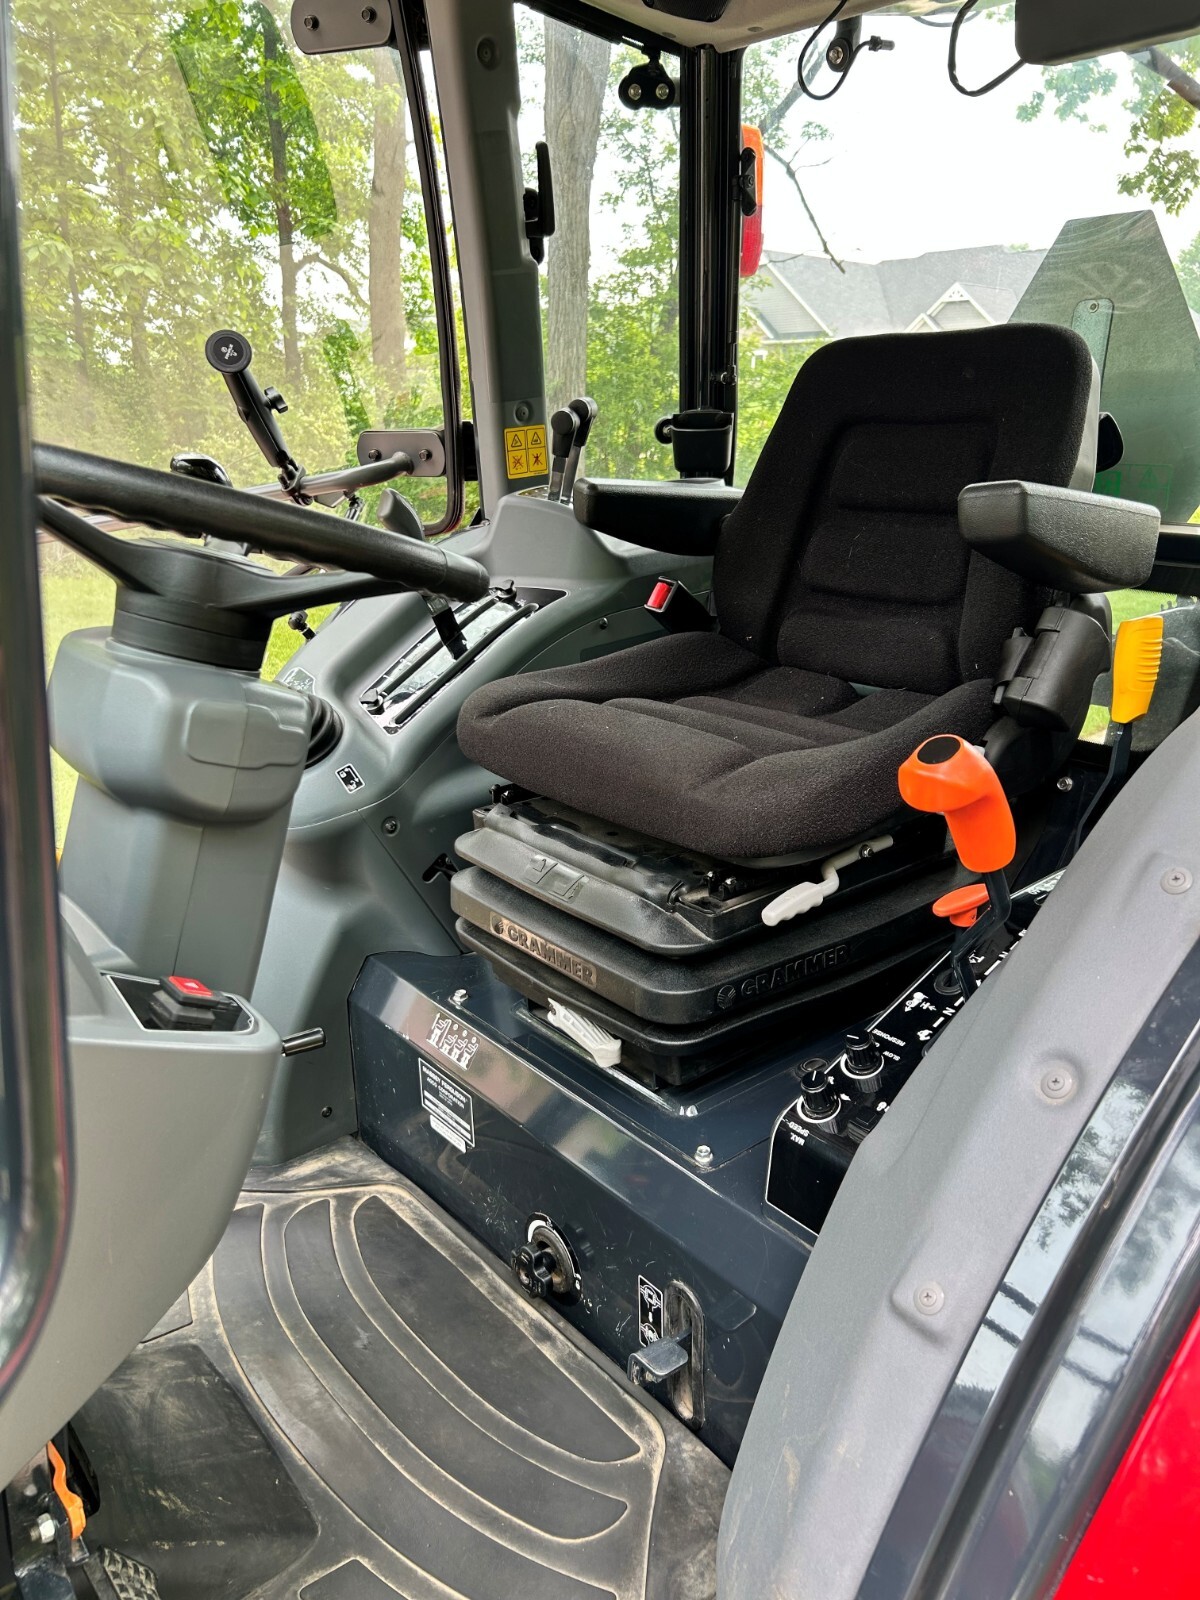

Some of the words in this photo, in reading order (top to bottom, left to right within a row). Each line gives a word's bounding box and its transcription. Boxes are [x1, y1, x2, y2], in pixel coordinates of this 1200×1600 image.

[507, 925, 593, 985] GRAMMER
[741, 945, 848, 996] GRAMMER
[942, 1006, 956, 1016] N
[872, 1028, 906, 1047] RESPONSE
[882, 1050, 901, 1061] SLOW
[788, 1121, 810, 1138] SPEED
